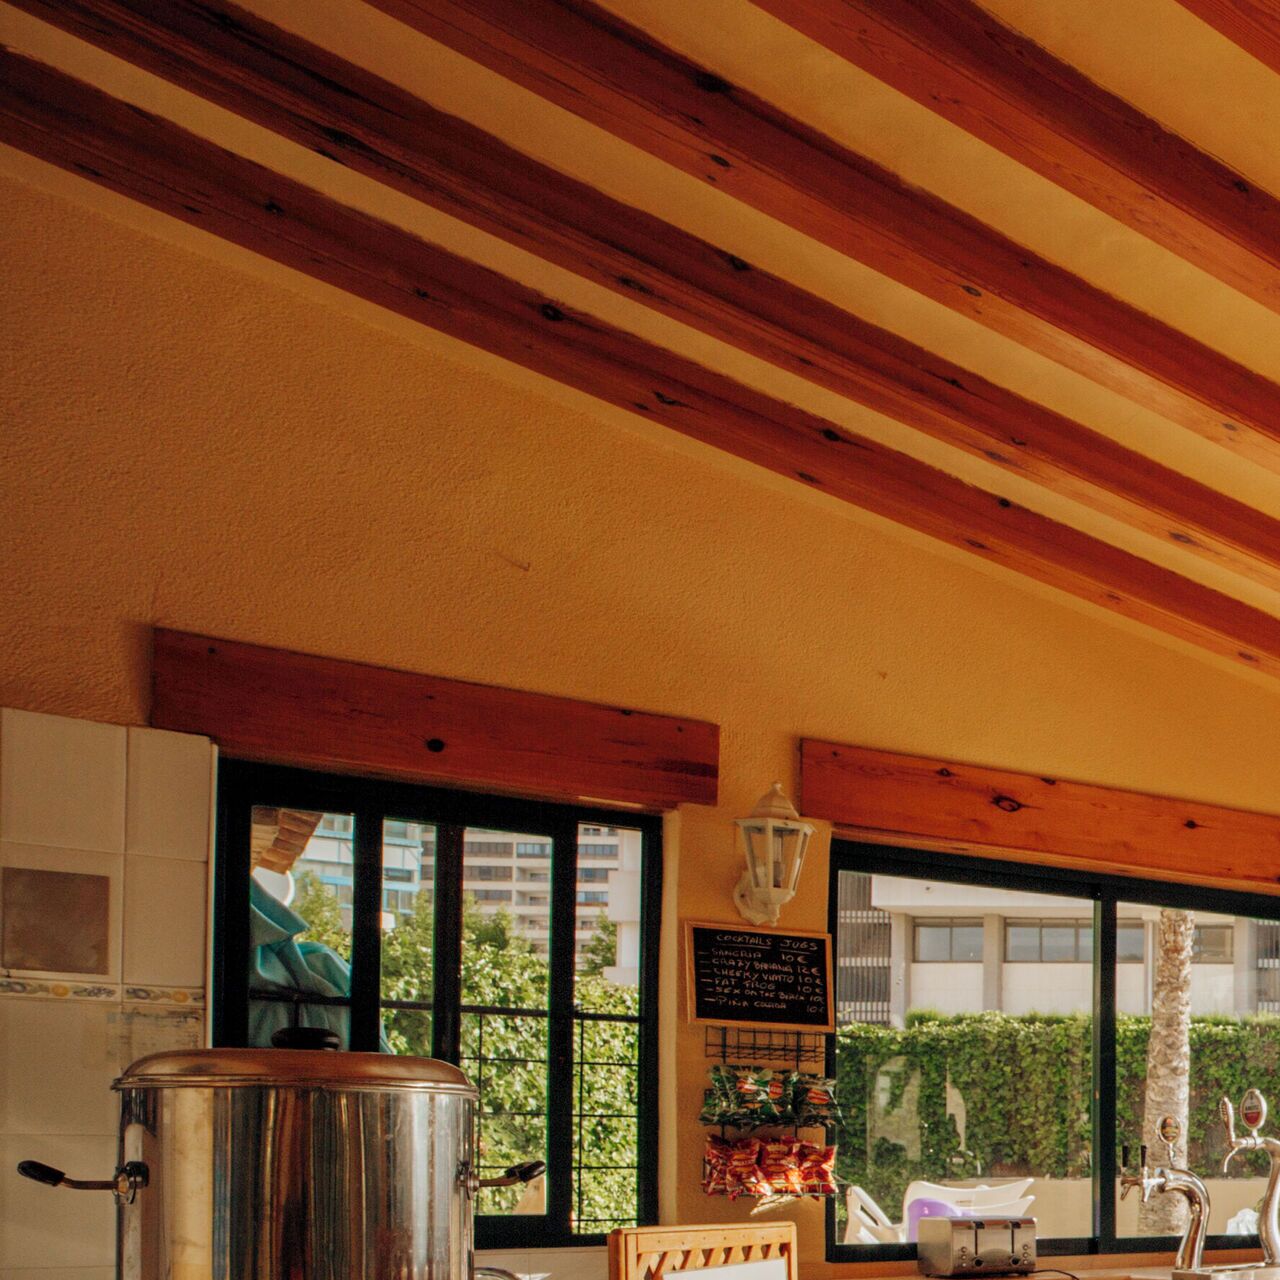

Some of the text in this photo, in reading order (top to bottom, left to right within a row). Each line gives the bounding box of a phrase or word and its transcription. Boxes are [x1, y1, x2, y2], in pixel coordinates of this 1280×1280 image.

[716, 934, 818, 951] COCKTAILS JUGS
[711, 948, 762, 958] SANGRIA
[712, 958, 751, 970] CRAZY
[753, 961, 793, 973] BANANA
[713, 967, 759, 980] CHEEKY
[714, 977, 738, 986] FAT
[743, 980, 776, 990] FROG
[715, 986, 741, 995] SEX
